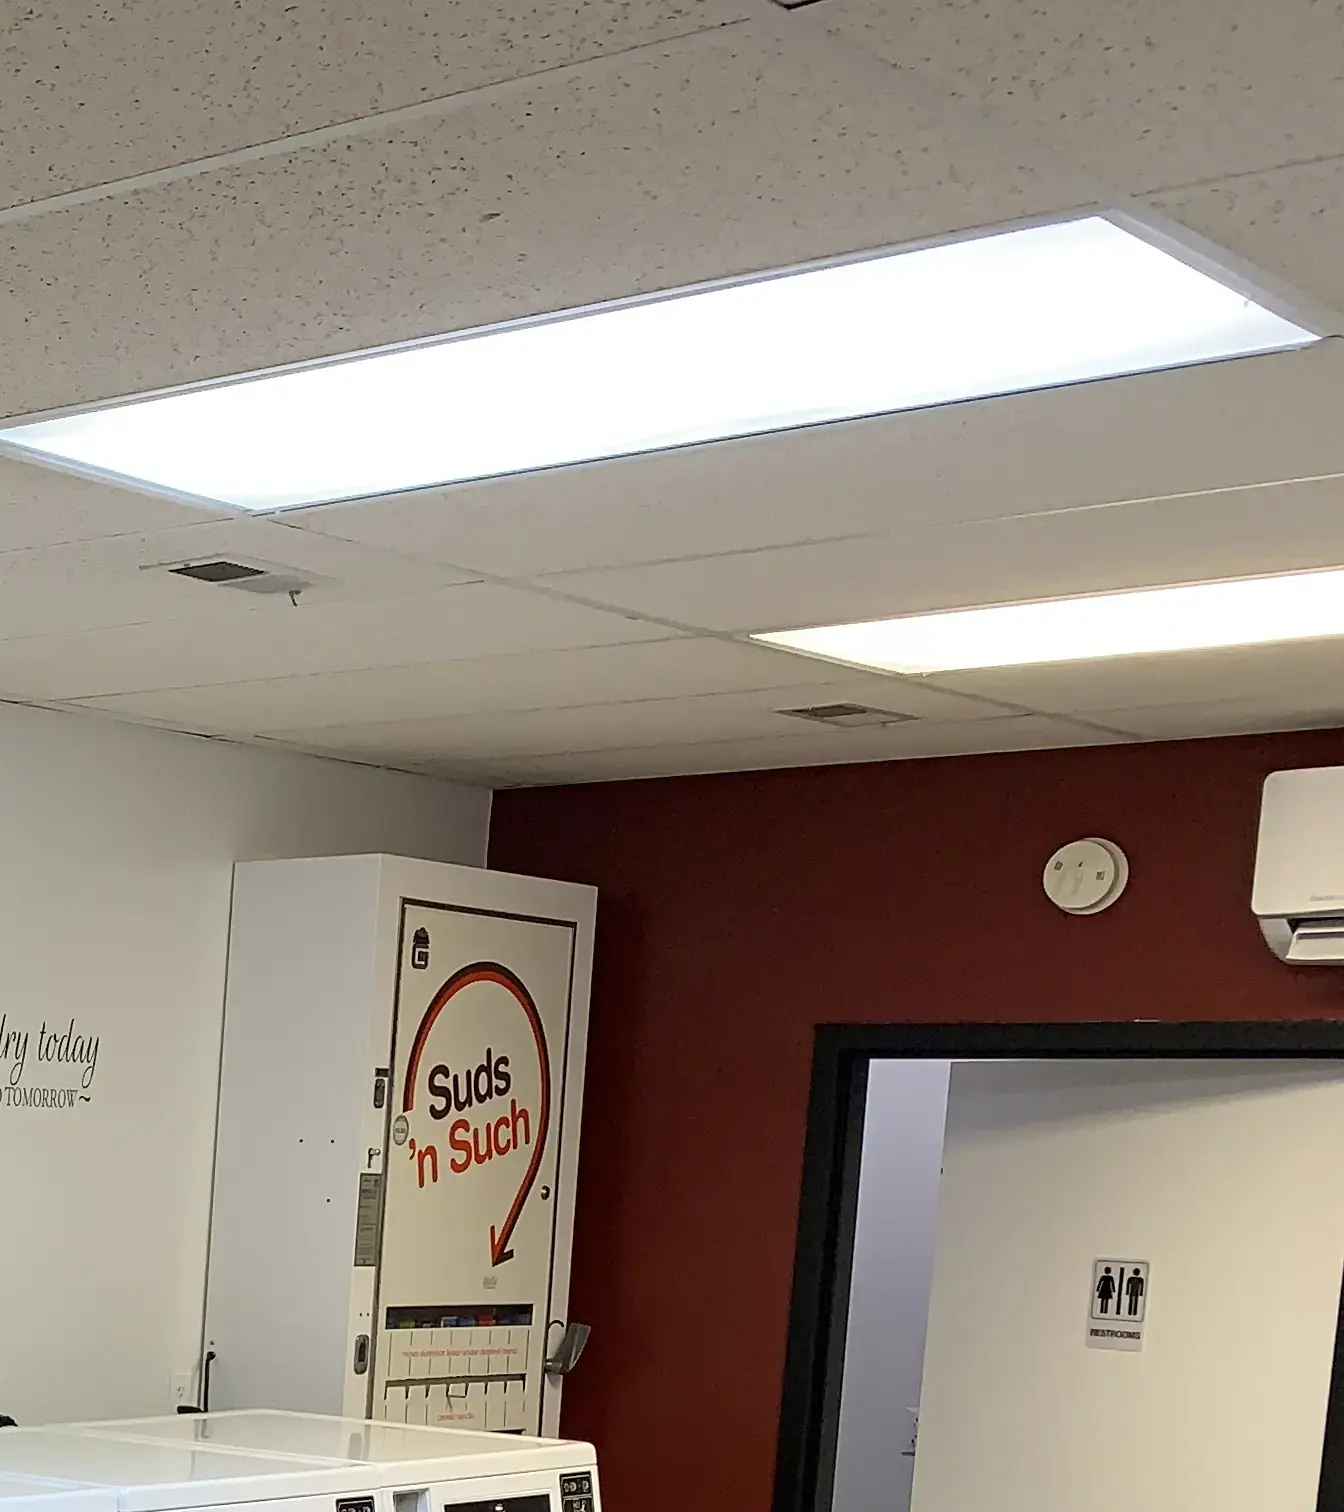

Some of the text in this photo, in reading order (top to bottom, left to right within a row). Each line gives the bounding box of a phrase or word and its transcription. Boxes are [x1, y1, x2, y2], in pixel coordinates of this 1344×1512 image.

[37, 1018, 100, 1089] today
[428, 1047, 512, 1120] Suds
[4, 1086, 78, 1108] TOMORROW
[449, 1098, 531, 1174] Such
